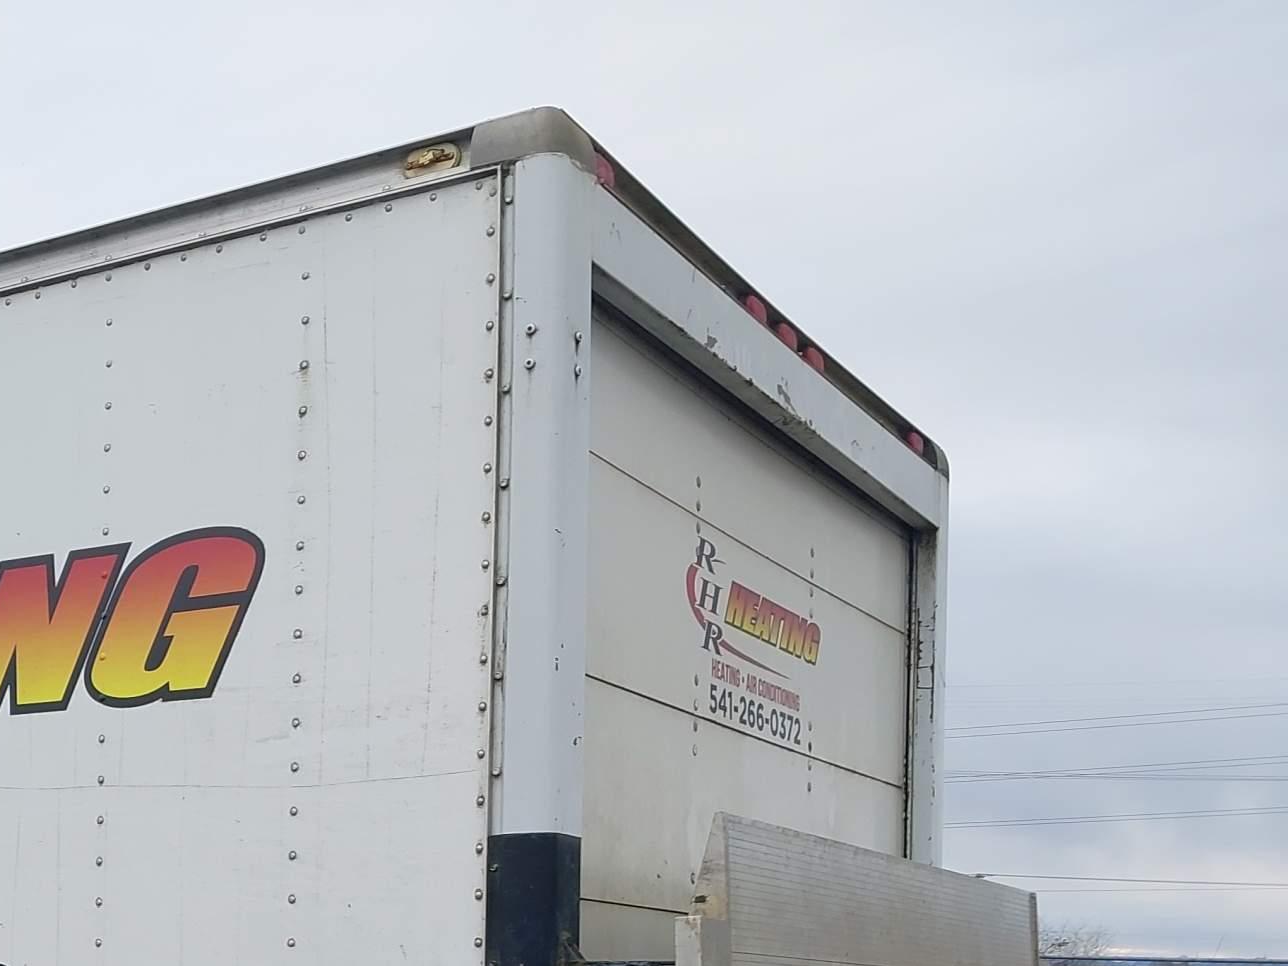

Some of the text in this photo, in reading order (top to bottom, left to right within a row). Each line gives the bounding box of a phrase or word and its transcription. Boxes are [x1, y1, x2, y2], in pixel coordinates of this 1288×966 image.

[724, 580, 821, 666] HEATING
[712, 658, 740, 688] HEATING
[746, 673, 757, 695] AIR
[709, 683, 801, 745] 541-266-0372
